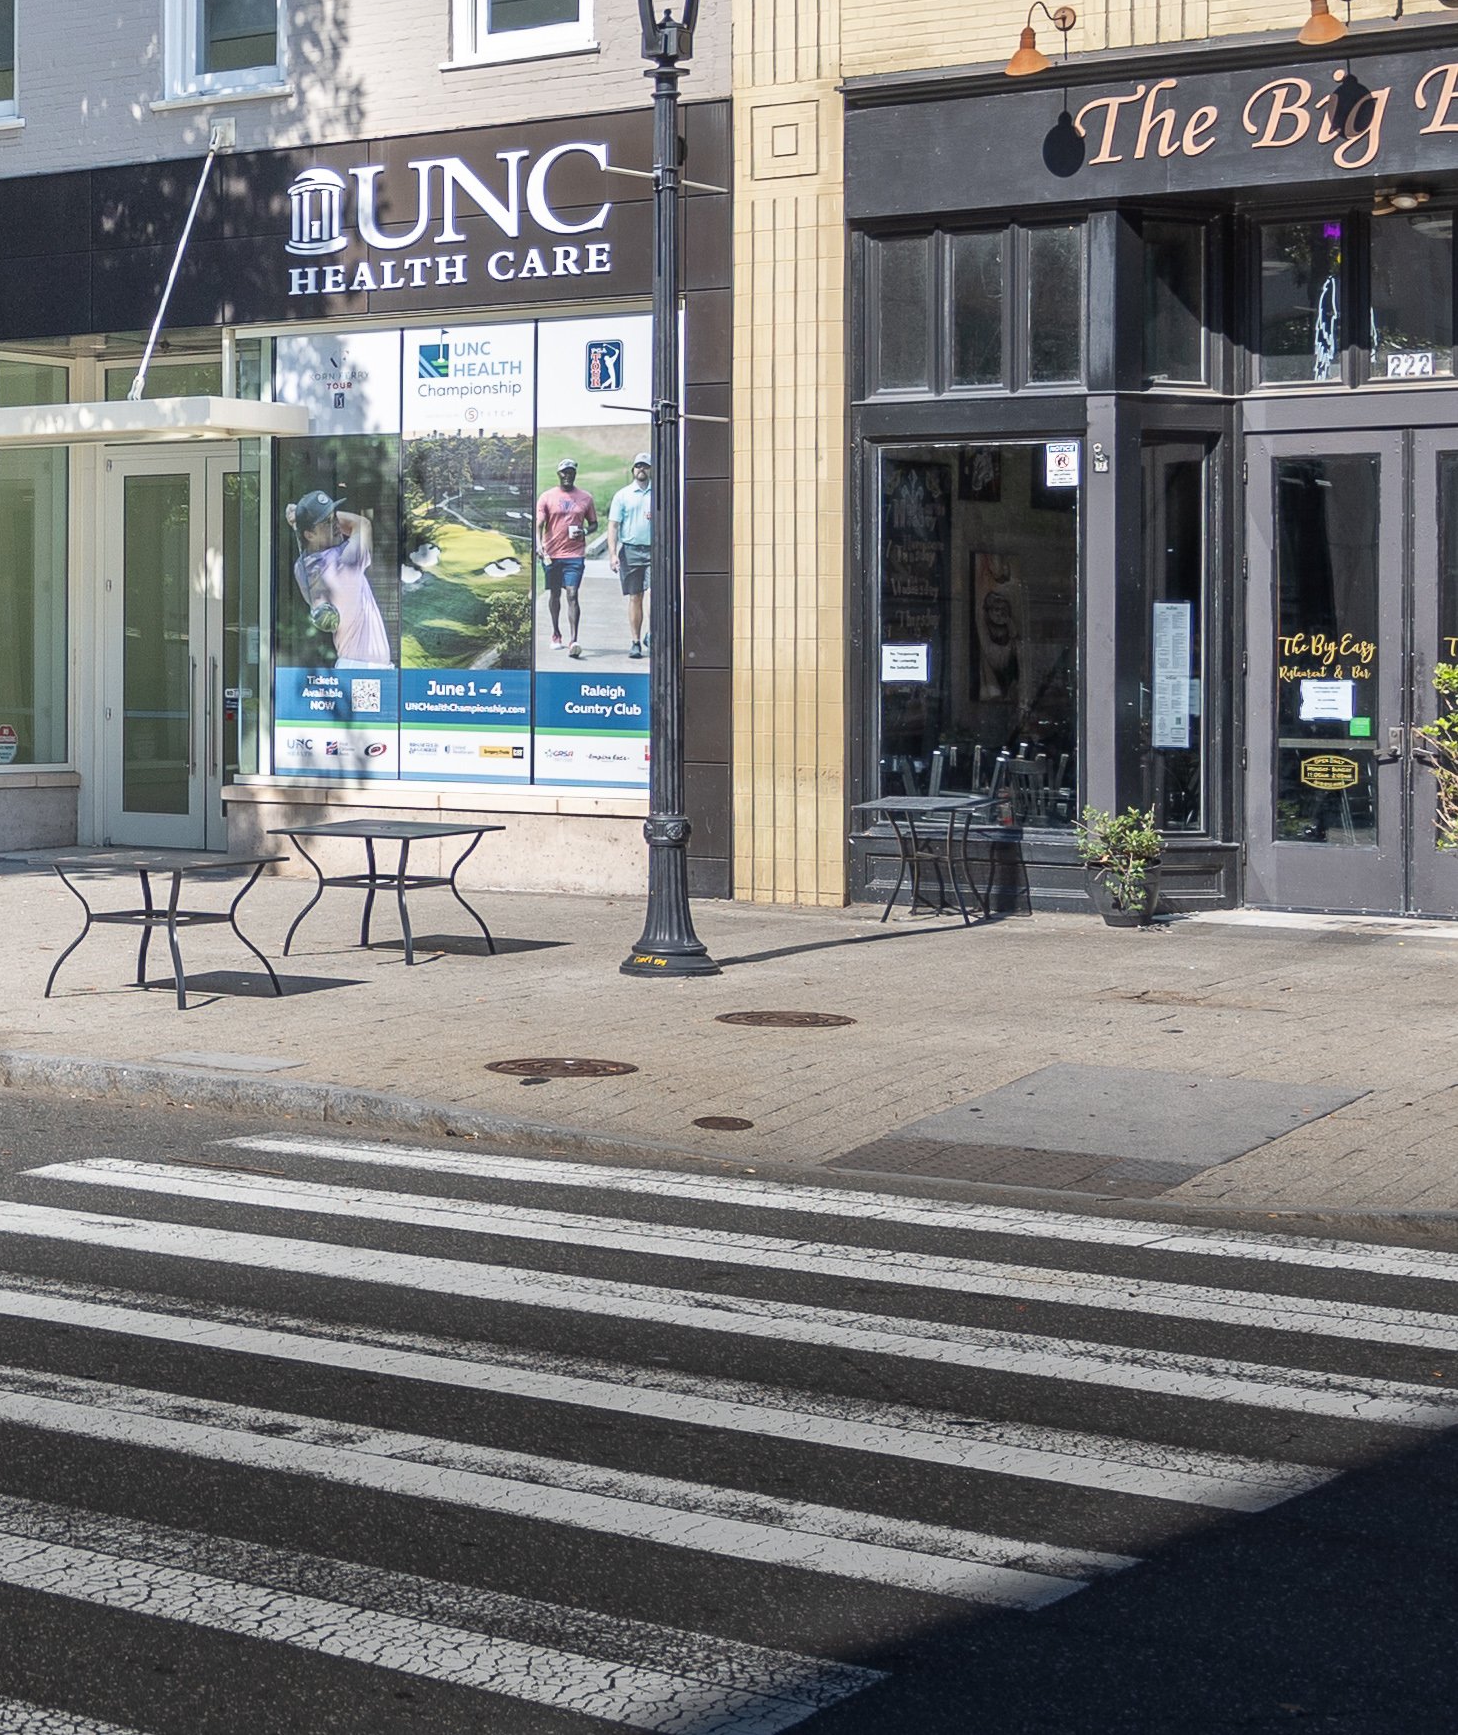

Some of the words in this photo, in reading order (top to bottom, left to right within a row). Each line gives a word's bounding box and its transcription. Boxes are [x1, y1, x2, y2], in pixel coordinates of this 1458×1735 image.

[1074, 78, 1219, 166] The
[1242, 68, 1392, 170] Big
[348, 143, 614, 250] UNC
[288, 254, 468, 297] HEALTH
[486, 241, 613, 283] CARE
[454, 341, 491, 357] UNC
[453, 360, 522, 378] HEALTH
[1390, 354, 1430, 377] 222
[327, 381, 353, 390] TOUR
[417, 380, 522, 400] Championship
[1278, 633, 1309, 656] The
[1311, 634, 1338, 665] Big
[1340, 633, 1377, 664] Easy
[307, 675, 339, 685] Tickets
[1280, 666, 1327, 683] Restaurant
[1334, 665, 1343, 679] &
[1352, 666, 1371, 679] Bar
[302, 688, 343, 698] Available
[427, 680, 465, 696] June
[467, 682, 477, 696] 1
[490, 682, 503, 696] 4
[580, 684, 626, 700] Raleigh
[310, 700, 336, 710] NOW
[405, 702, 526, 715] UNCHealthChampionship.com
[564, 701, 613, 717] Country
[613, 702, 642, 716] Club
[287, 738, 313, 750] UNC
